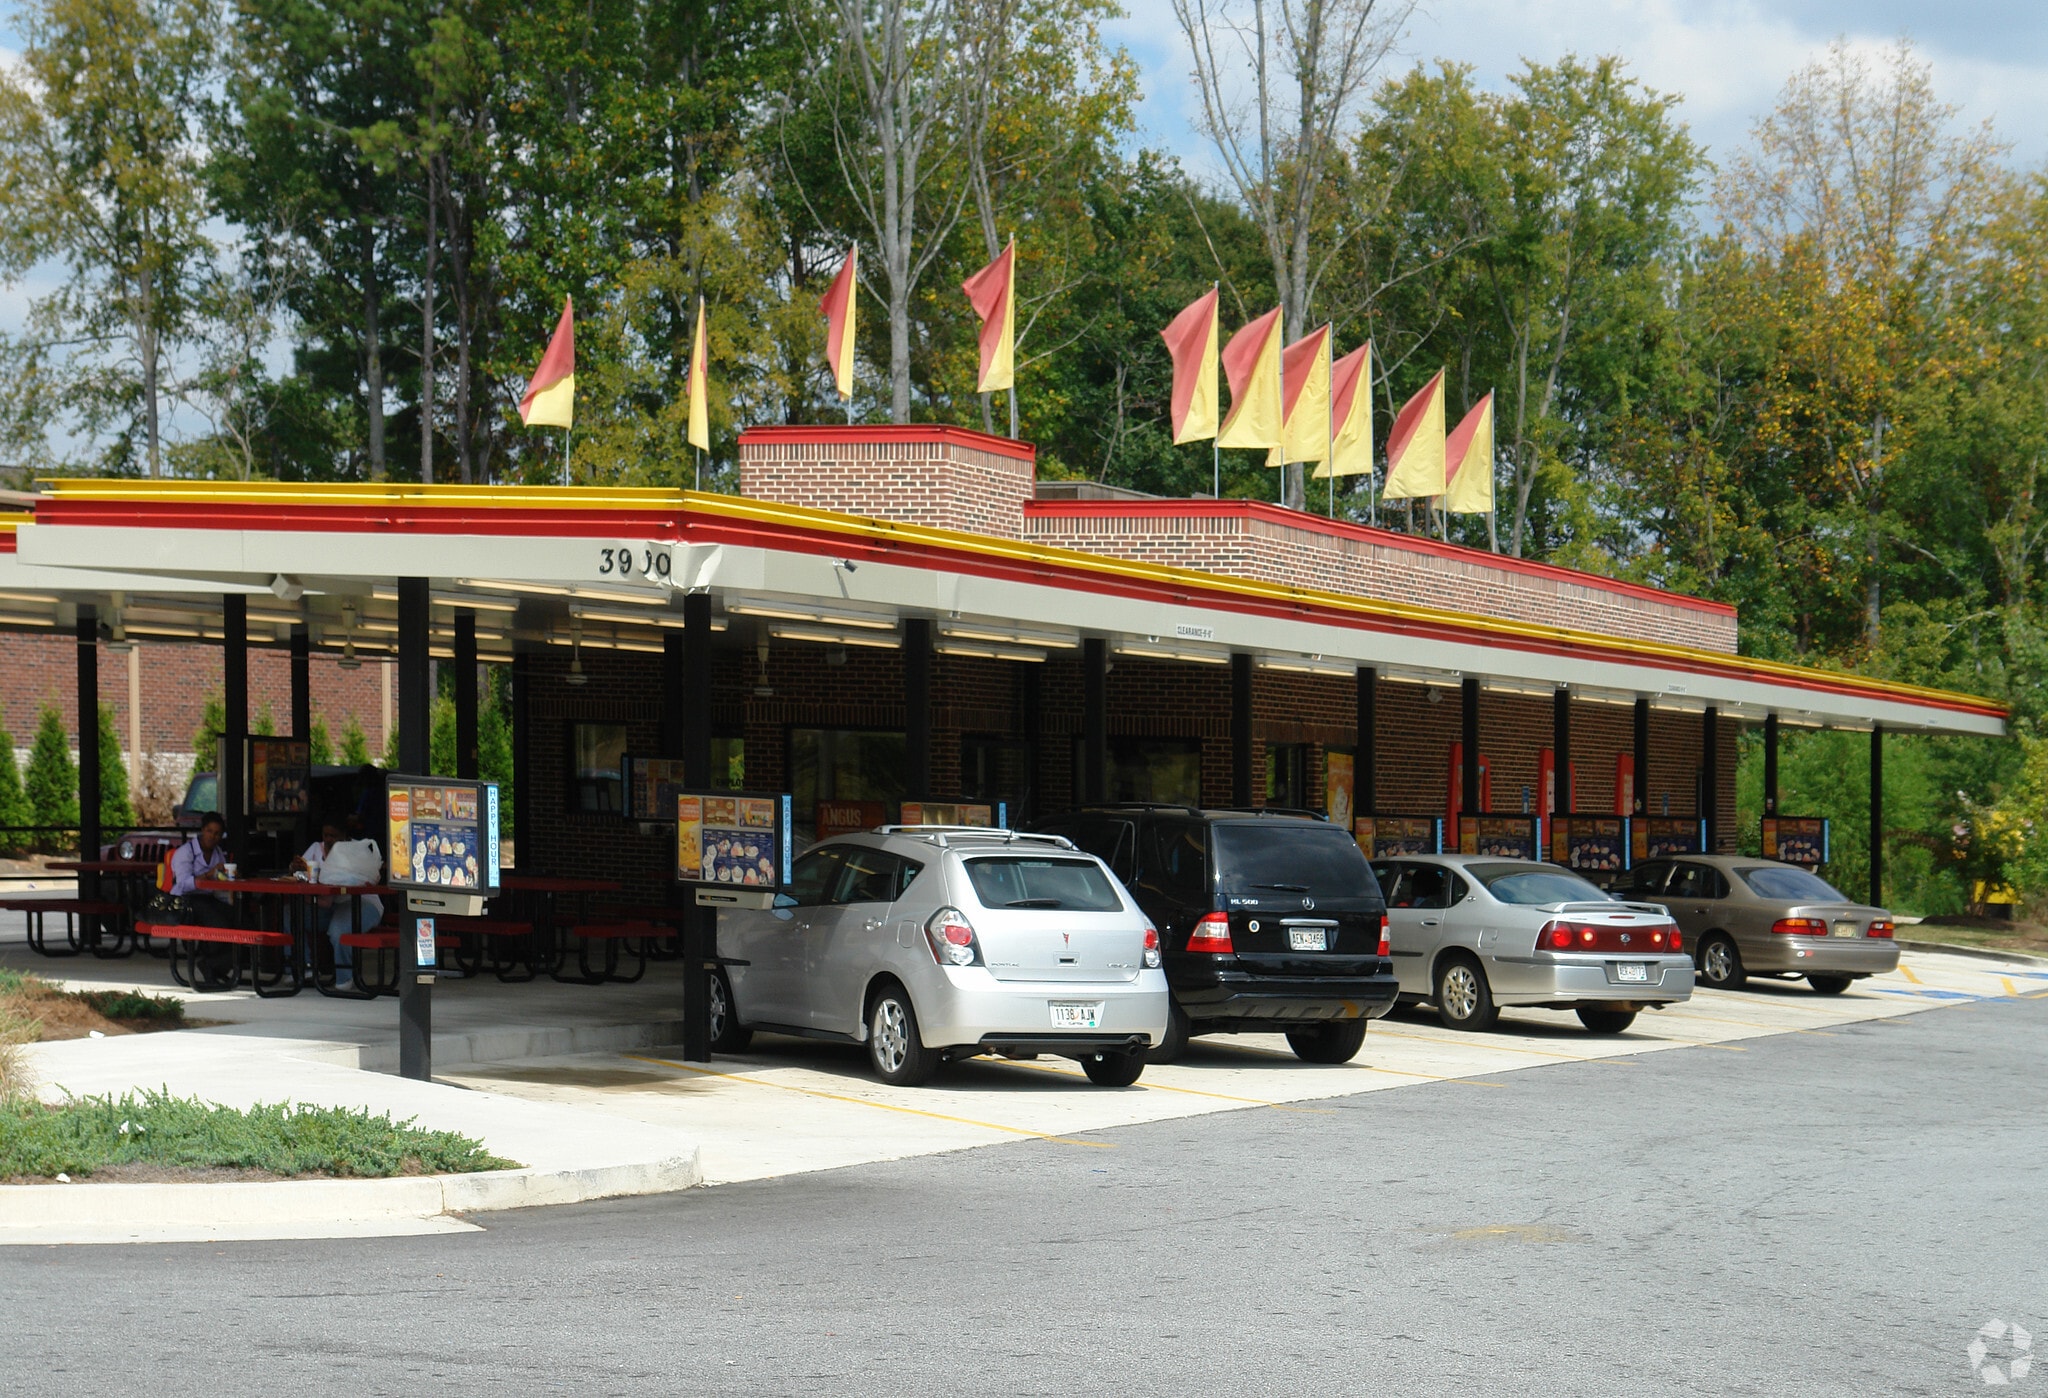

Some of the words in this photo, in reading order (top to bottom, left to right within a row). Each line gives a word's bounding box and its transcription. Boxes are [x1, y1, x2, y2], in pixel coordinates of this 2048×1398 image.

[489, 789, 497, 827] HAPPY
[822, 808, 861, 826] ANGUS
[489, 835, 497, 866] HOUR
[1242, 898, 1259, 906] 500
